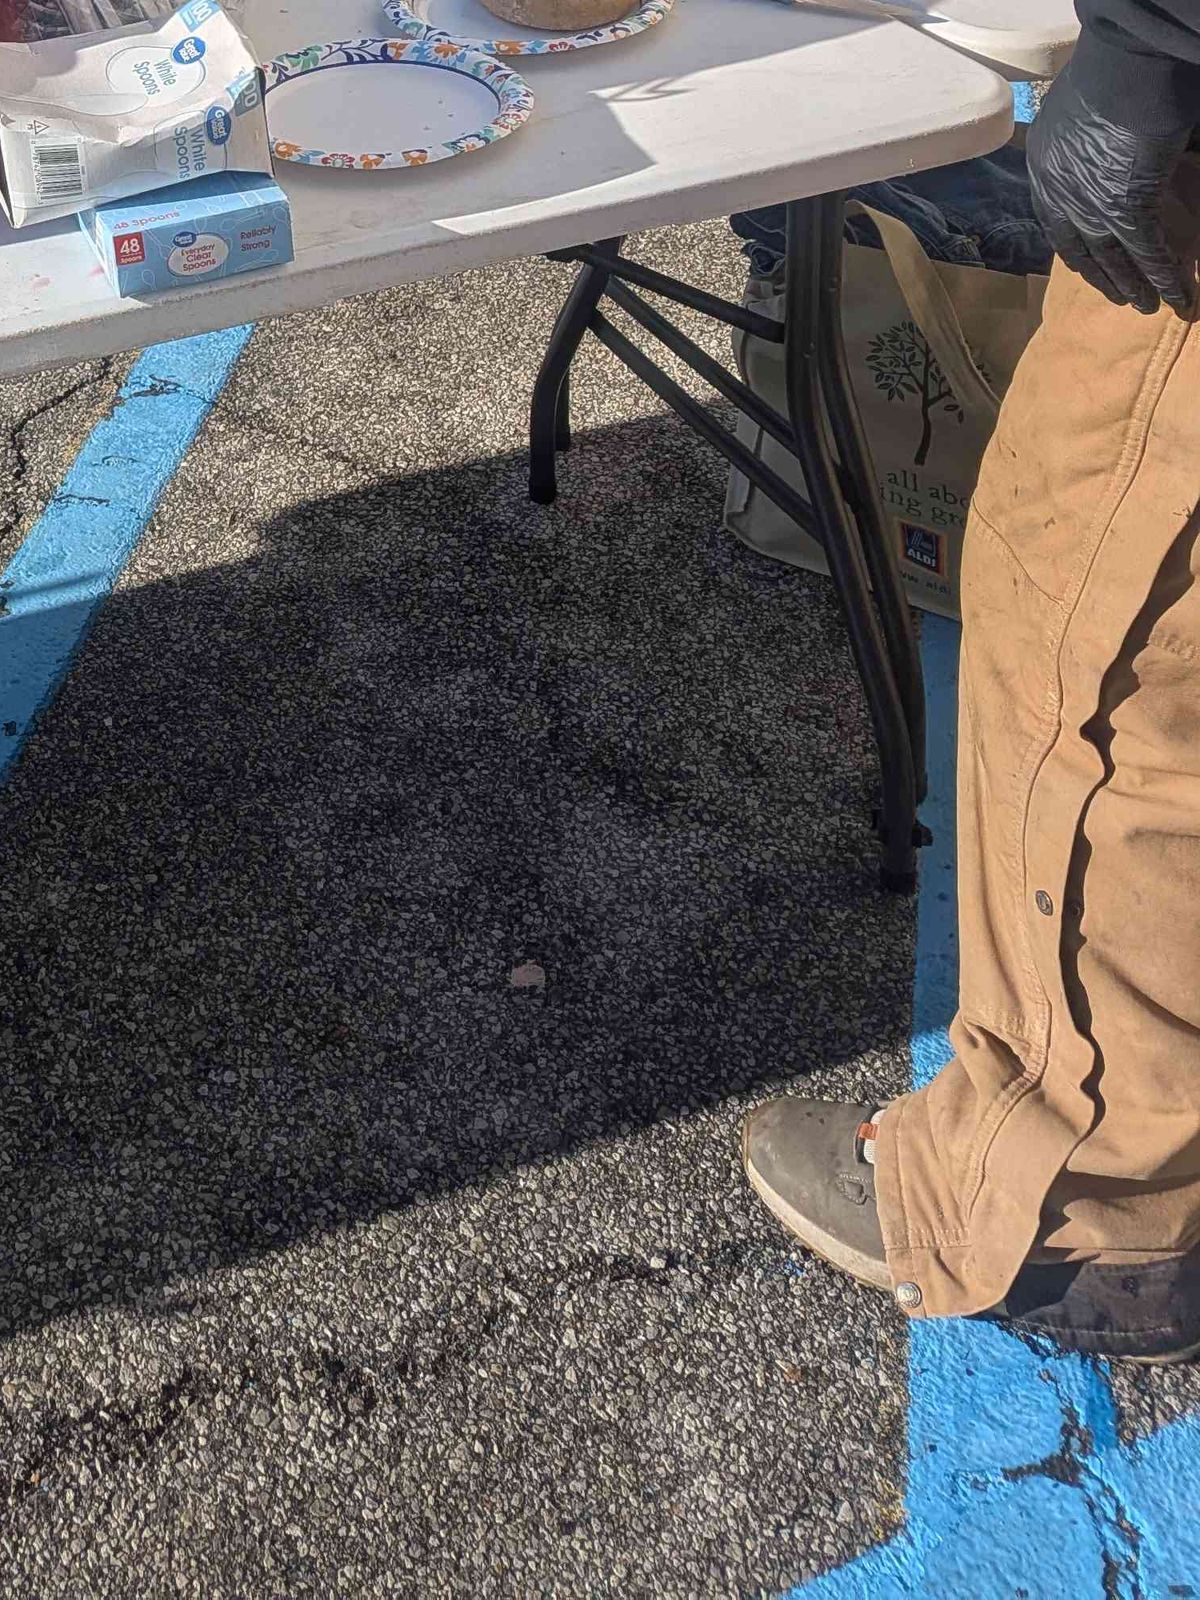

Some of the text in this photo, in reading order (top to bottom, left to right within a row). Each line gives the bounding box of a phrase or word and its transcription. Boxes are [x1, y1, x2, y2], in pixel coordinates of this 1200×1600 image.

[183, 38, 201, 59] Great
[134, 61, 161, 96] Spoons
[154, 59, 177, 86] White
[215, 109, 227, 137] Great
[173, 126, 190, 179] Spoons
[190, 128, 207, 172] White
[114, 222, 129, 231] 48
[240, 225, 277, 240] Reliably
[120, 238, 140, 255] 48
[174, 233, 194, 243] Great
[241, 240, 271, 252] Strong
[181, 243, 216, 257] Everyday
[186, 252, 212, 263] Clear
[182, 258, 217, 272] Spoons
[887, 470, 918, 492] all
[880, 482, 921, 517] ing
[907, 548, 937, 568] ALDI
